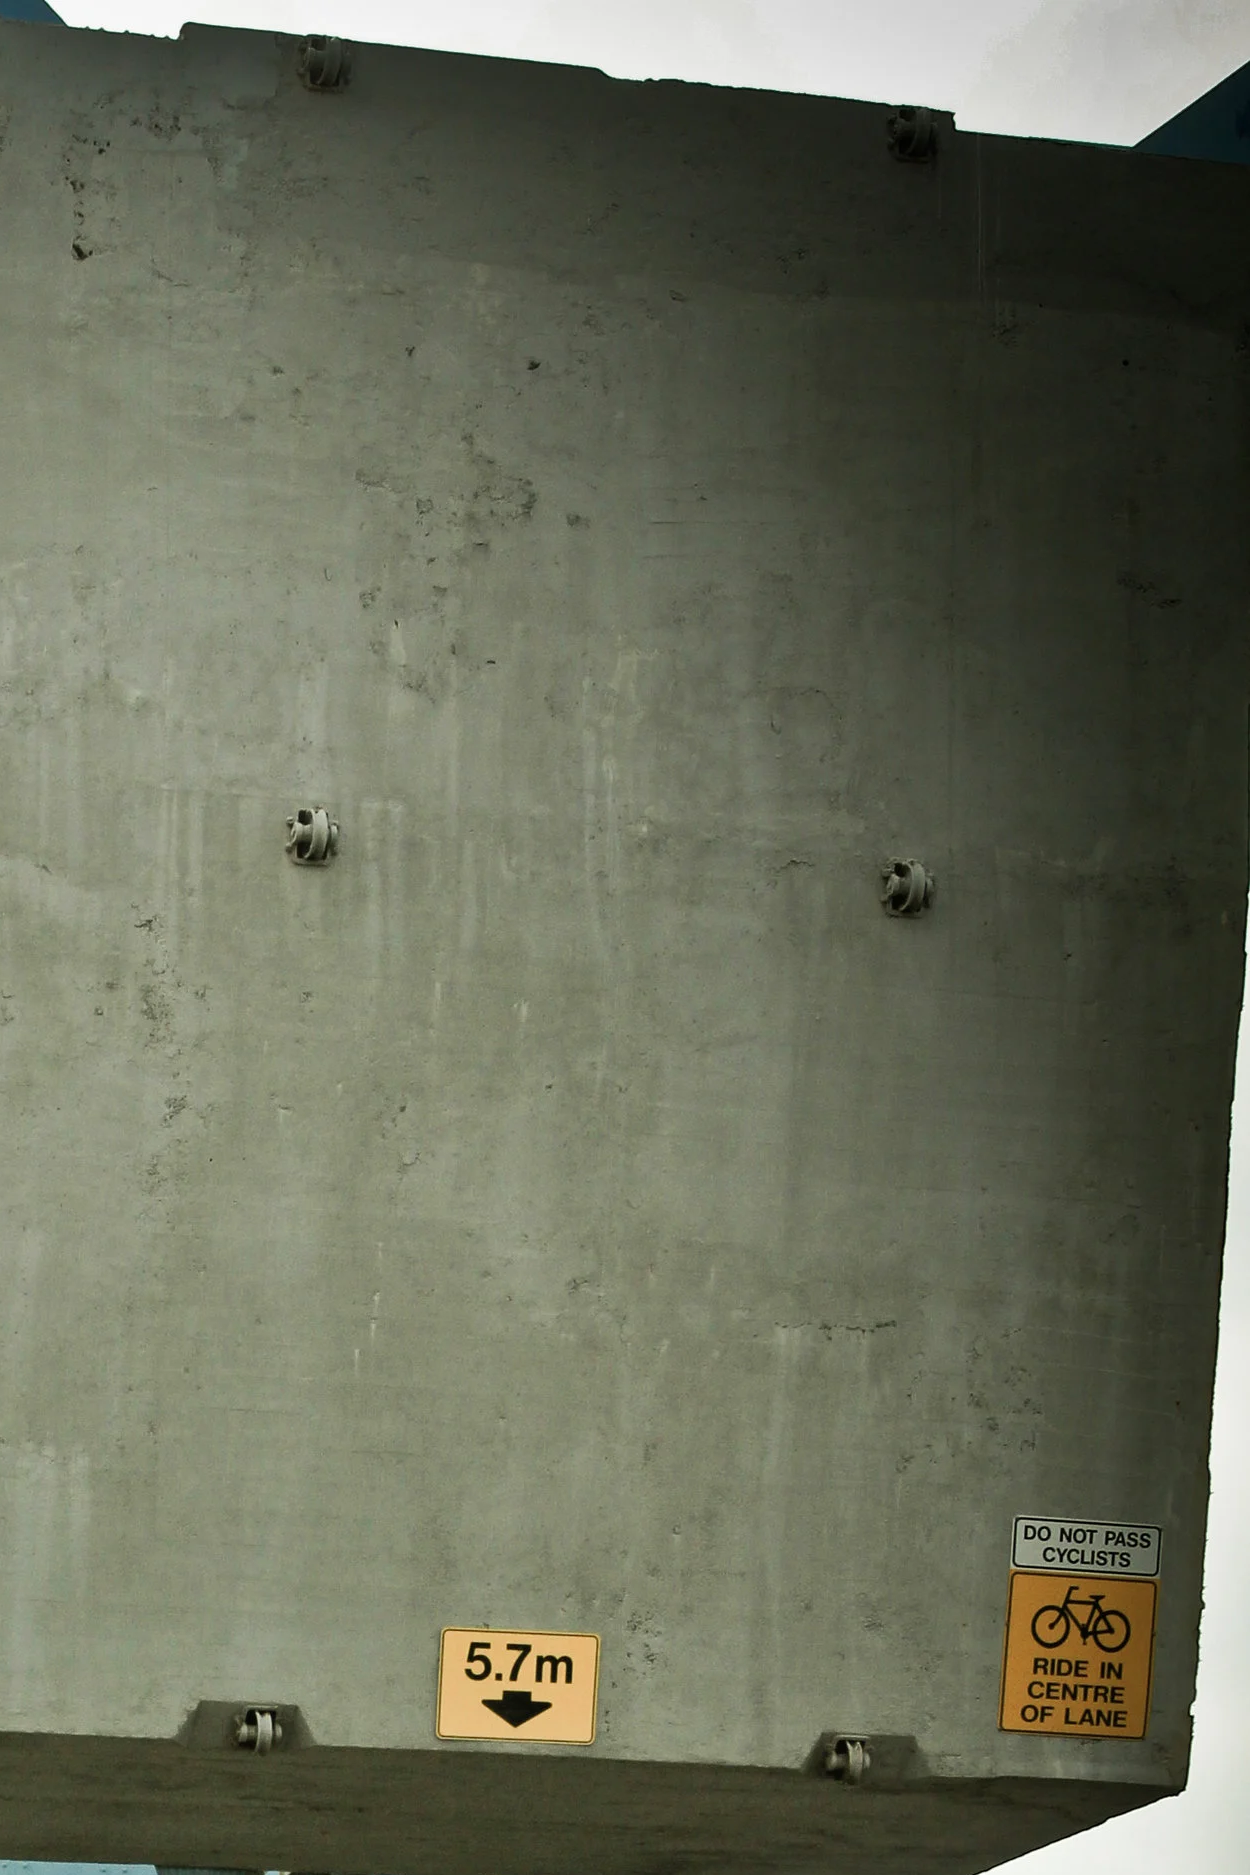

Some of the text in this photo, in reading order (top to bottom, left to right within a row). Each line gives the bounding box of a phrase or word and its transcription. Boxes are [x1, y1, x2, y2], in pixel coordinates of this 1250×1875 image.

[1023, 1525, 1151, 1548] DO NOT PASS
[1042, 1547, 1131, 1567] CYCLISTS
[464, 1641, 573, 1684] 5.7m
[1032, 1658, 1123, 1679] RIDE IN
[1027, 1681, 1125, 1704] CENTRE
[1020, 1704, 1128, 1728] OF LANE
